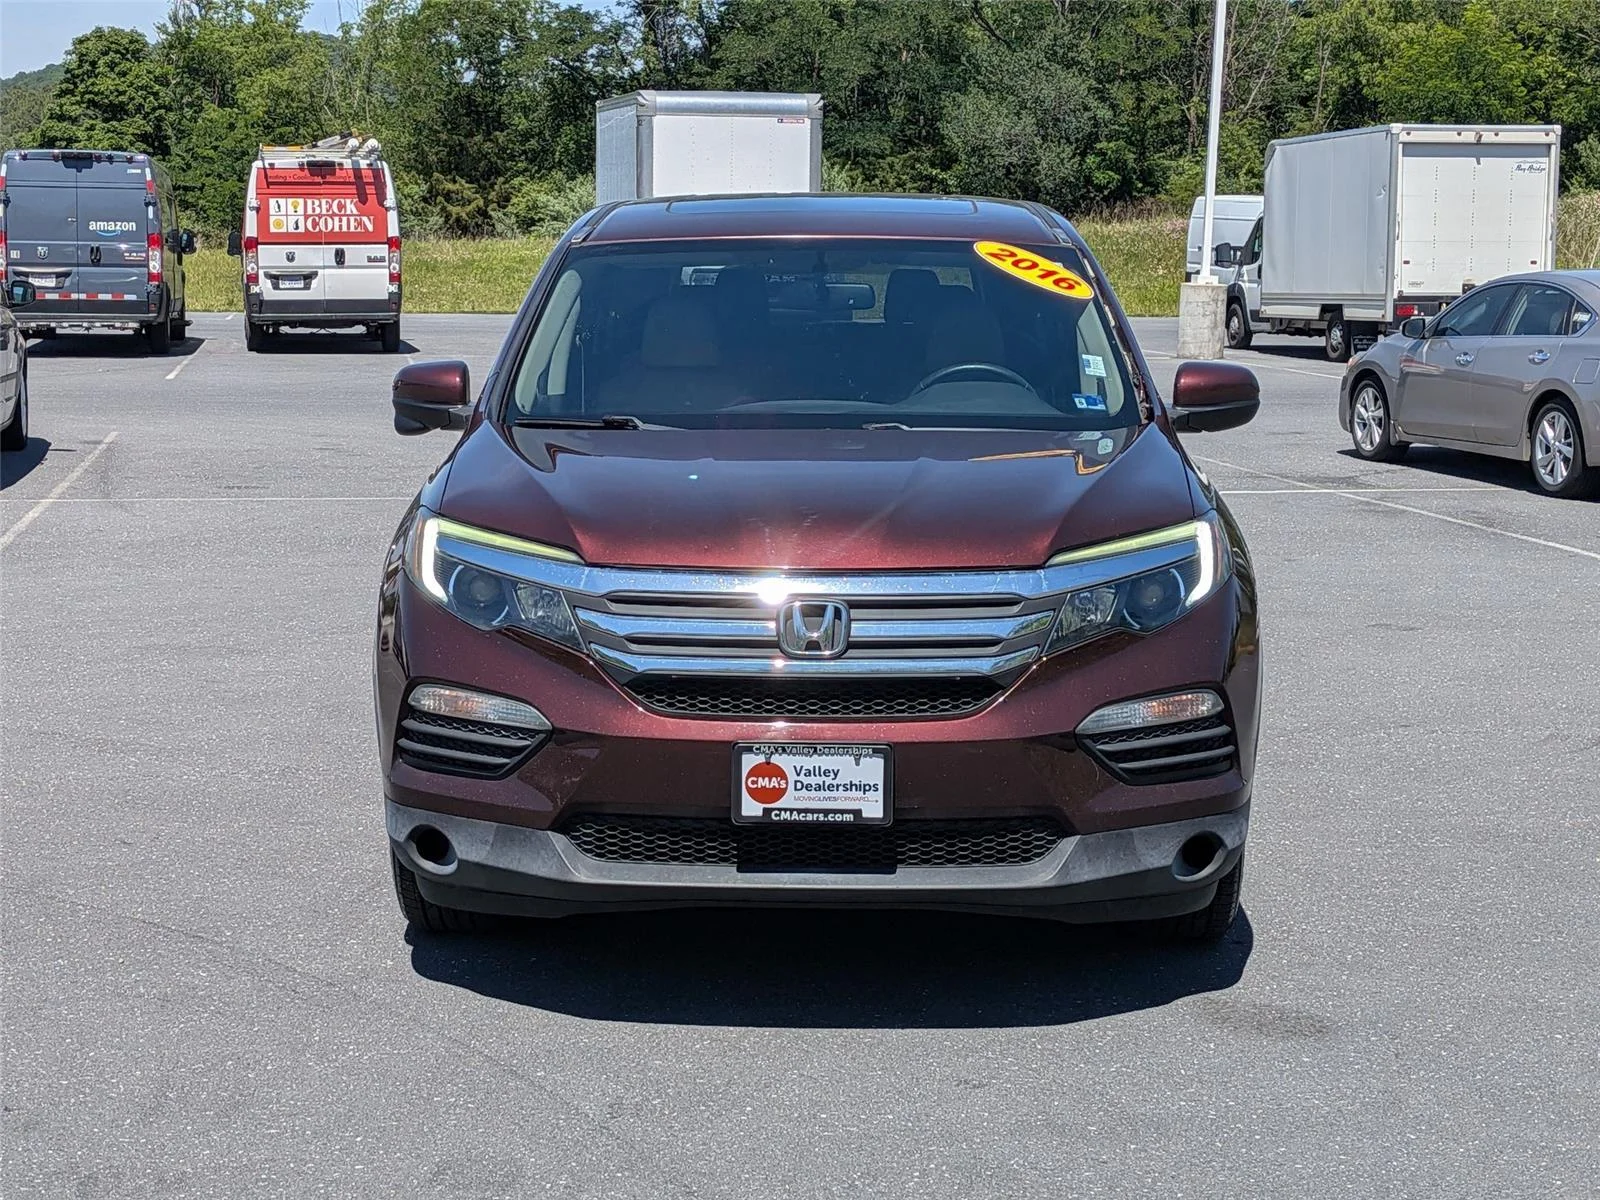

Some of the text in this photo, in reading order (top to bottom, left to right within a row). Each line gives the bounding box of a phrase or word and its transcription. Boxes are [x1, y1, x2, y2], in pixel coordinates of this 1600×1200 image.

[305, 198, 359, 214] BECK
[88, 220, 137, 231] amazon
[306, 216, 374, 232] COHEN
[985, 248, 1082, 290] 2016
[752, 745, 873, 756] CMA's Valley Dealerships
[793, 765, 840, 780] Valley
[747, 776, 787, 788] CMA's
[794, 780, 879, 795] Dealerships
[771, 810, 854, 822] CMAcars.com
